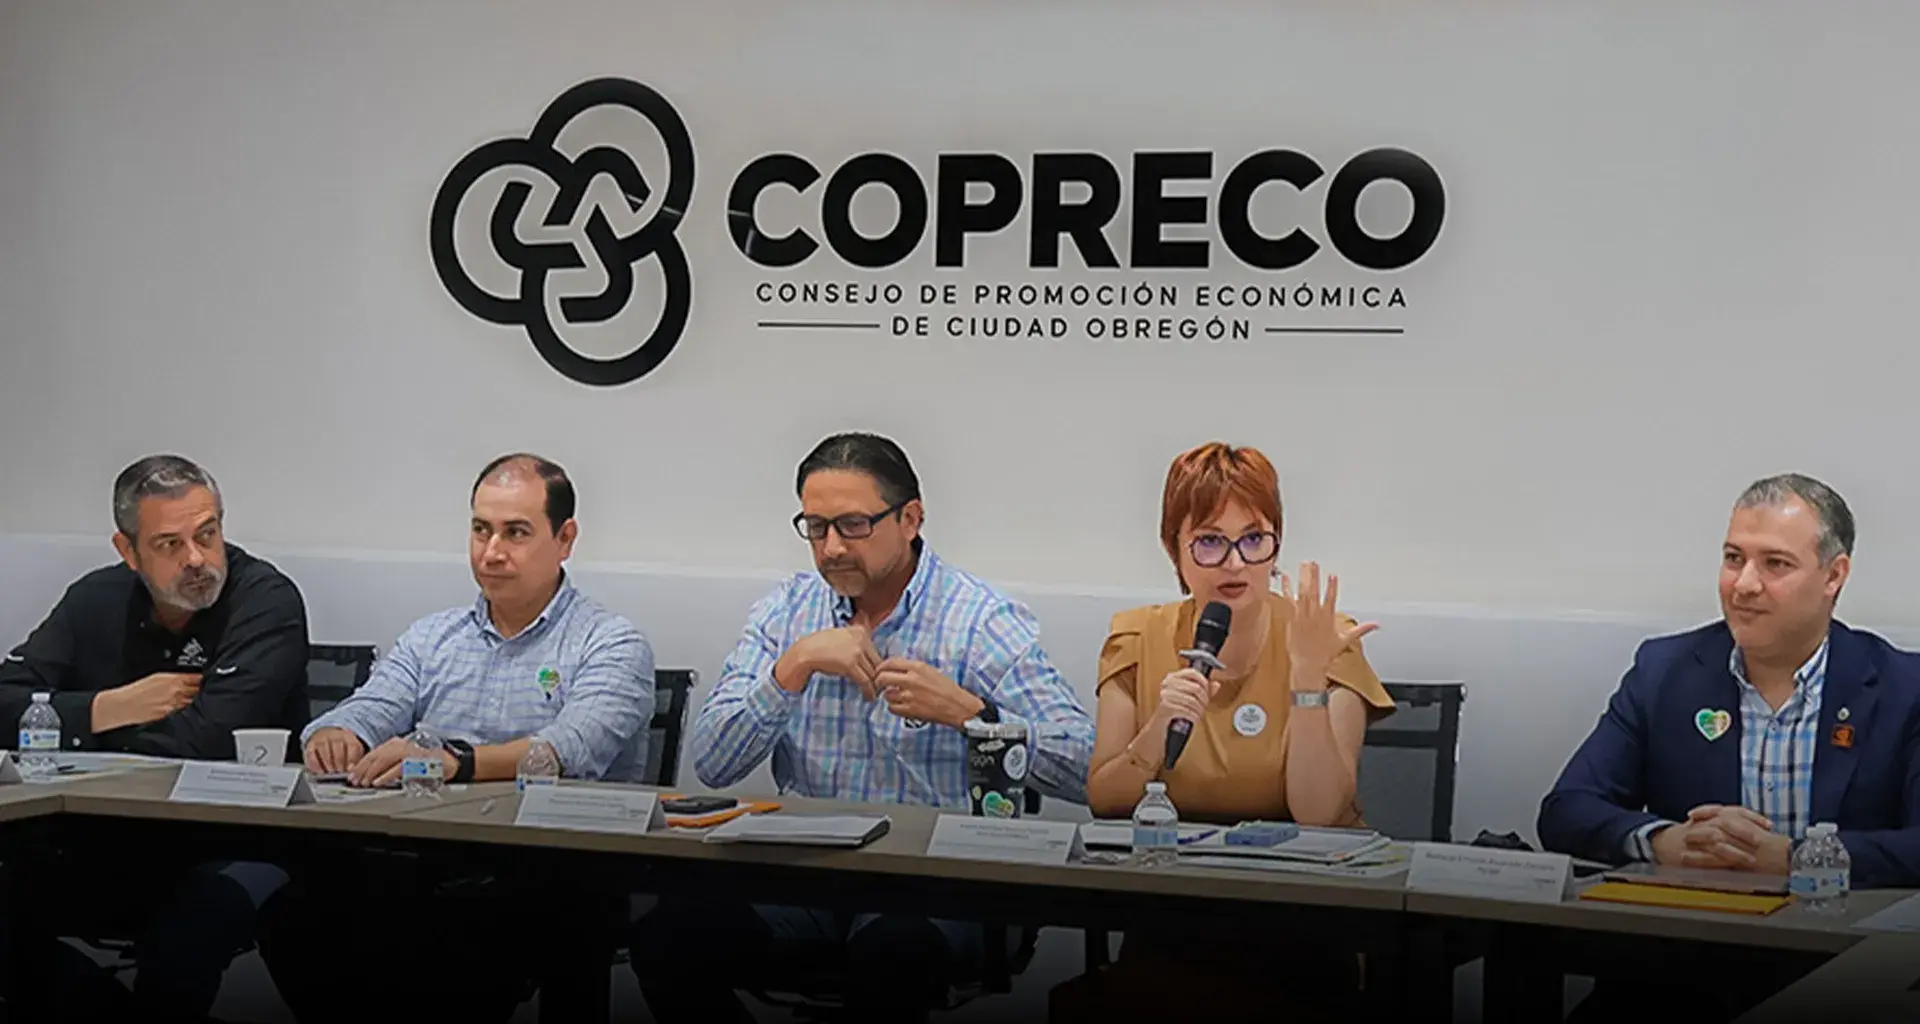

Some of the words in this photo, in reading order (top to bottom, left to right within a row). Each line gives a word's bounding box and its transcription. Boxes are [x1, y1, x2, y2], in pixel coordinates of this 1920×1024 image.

[727, 148, 1446, 270] COPRECO
[756, 282, 903, 304] CONSEJO
[920, 284, 957, 305] DE
[974, 281, 1177, 306] PROMOCIÓN
[1195, 282, 1407, 308] ECONÓMICA
[892, 316, 929, 337] DE
[946, 316, 1068, 338] CIUDAD
[1086, 316, 1249, 340] OBREGÓN
